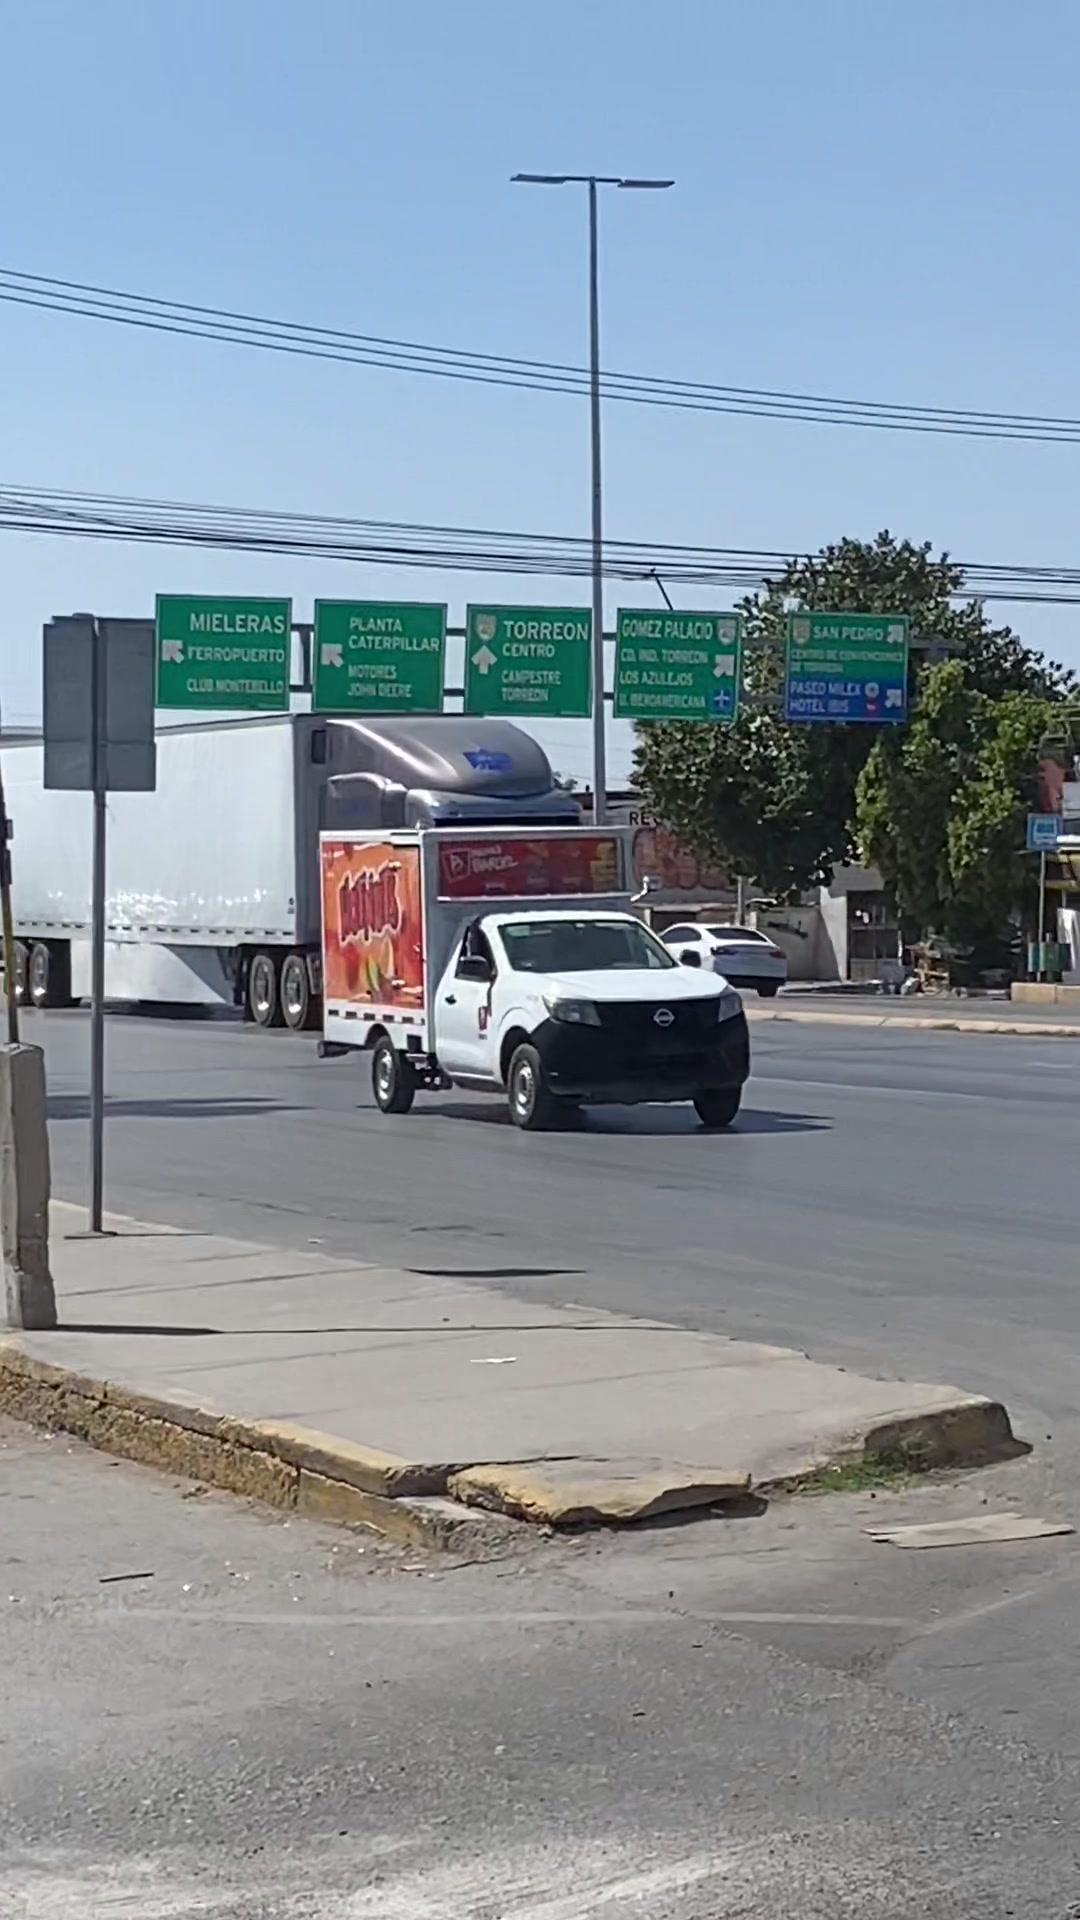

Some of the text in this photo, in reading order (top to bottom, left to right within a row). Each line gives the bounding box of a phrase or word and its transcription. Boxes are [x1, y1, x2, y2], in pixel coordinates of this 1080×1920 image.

[190, 612, 285, 634] MIELERAS
[350, 617, 403, 632] PLANTA
[503, 620, 589, 641] TORREON
[621, 619, 713, 640] GOMEZ PALACIO
[813, 626, 884, 641] SAN PEDRO
[348, 635, 440, 652] CATERPILLAR
[502, 643, 556, 658] CENTRO
[187, 646, 285, 663] FERROPUERTO
[348, 664, 397, 680] MOTORES
[501, 669, 562, 685] CAMPESTRE
[620, 671, 693, 686] LOS AZULEJOS
[186, 678, 213, 693] CLUB
[347, 682, 412, 698] JOHN DEERE
[501, 687, 549, 702] TORREON
[789, 699, 826, 713] HOTEL
